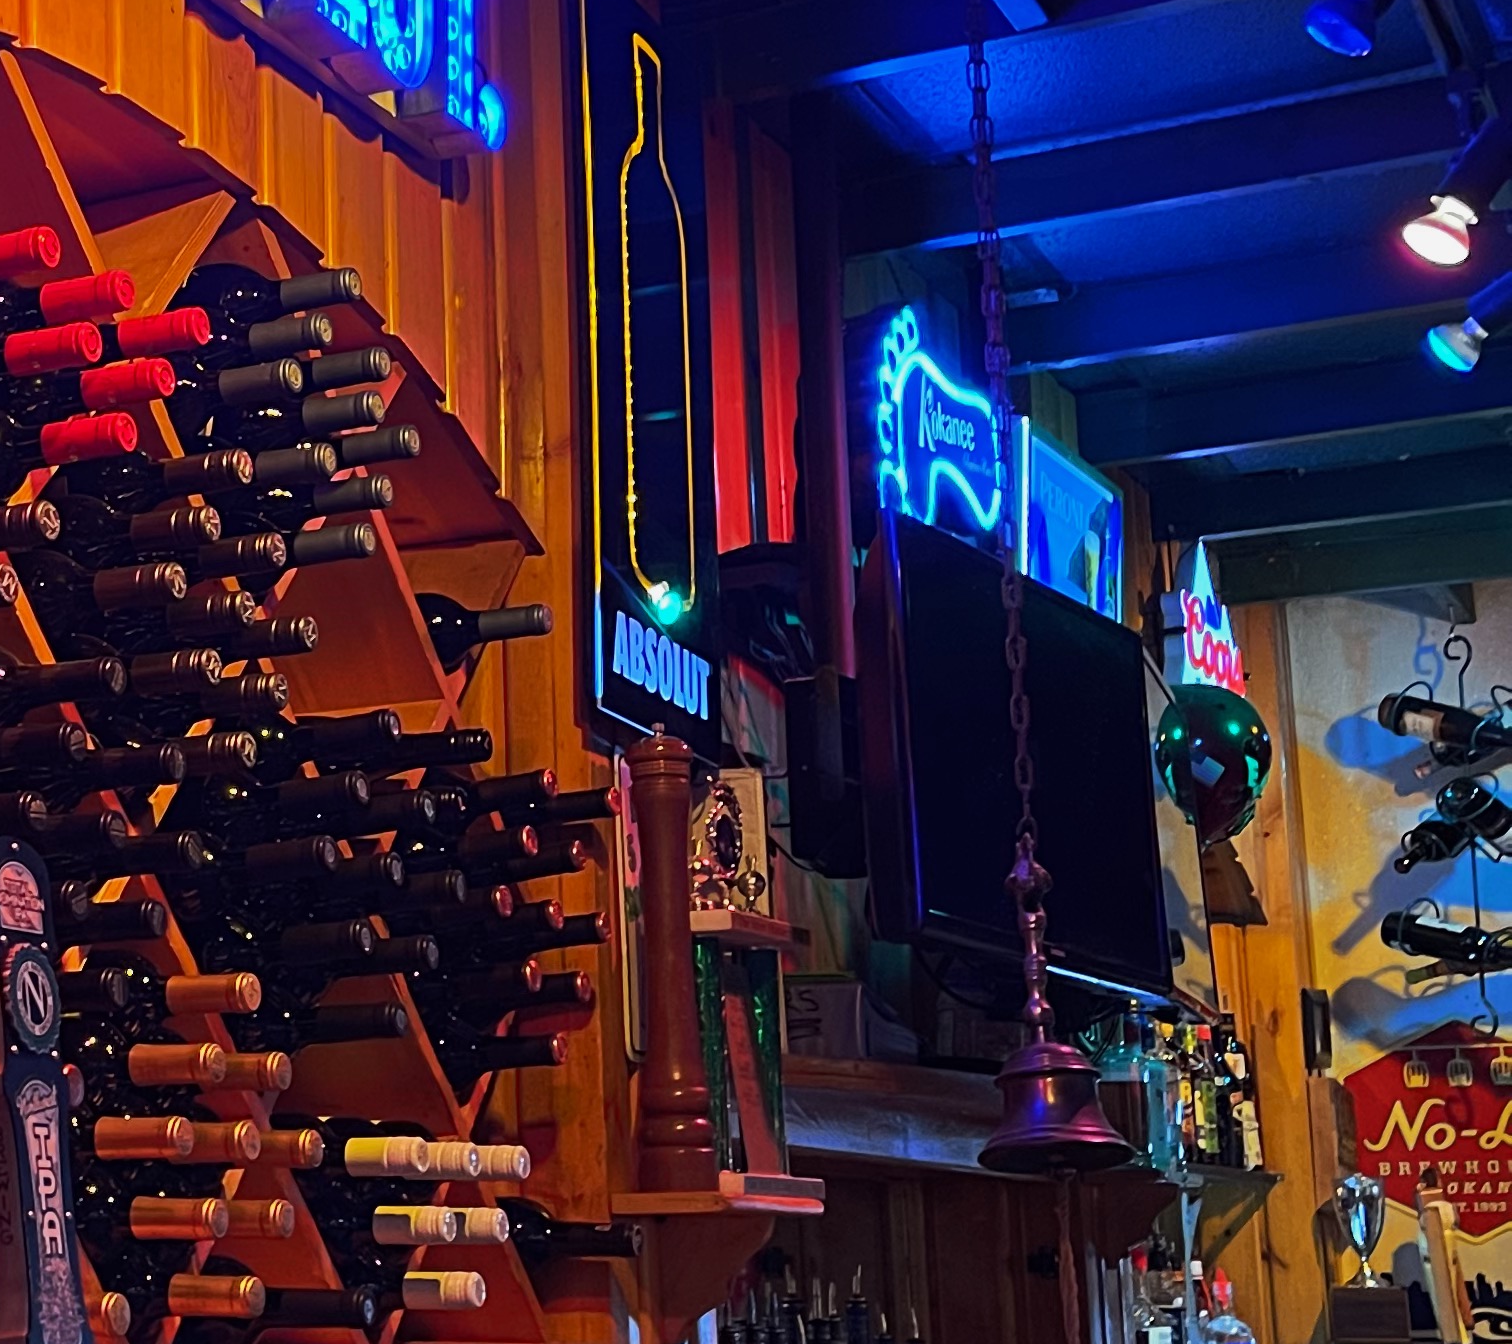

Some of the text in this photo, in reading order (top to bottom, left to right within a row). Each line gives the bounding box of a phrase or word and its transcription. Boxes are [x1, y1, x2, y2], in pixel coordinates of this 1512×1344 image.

[918, 372, 977, 453] Kokanee
[612, 609, 711, 721] ABSOLUT
[1446, 1180, 1512, 1196] OKAN
